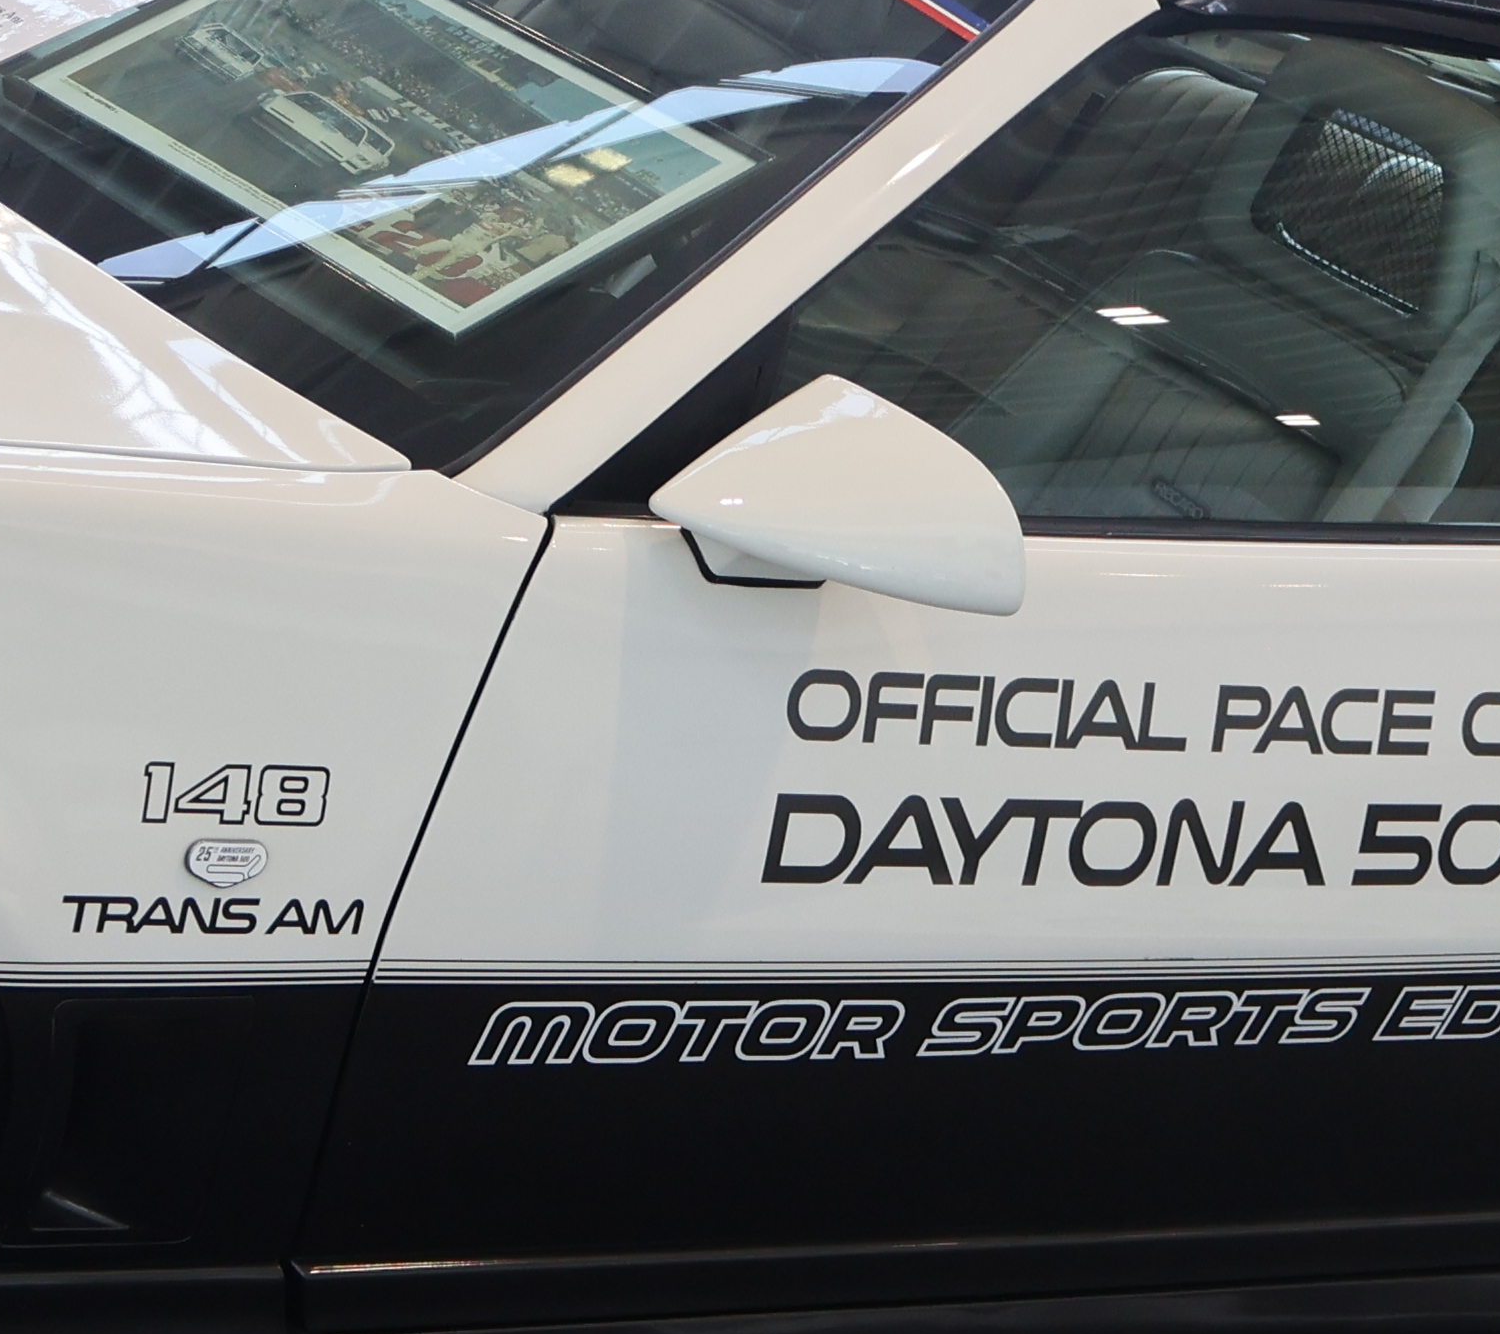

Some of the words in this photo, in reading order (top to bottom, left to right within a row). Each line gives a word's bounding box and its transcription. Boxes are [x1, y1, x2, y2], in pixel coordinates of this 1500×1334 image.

[786, 668, 1187, 751] OFFICIAL
[1211, 684, 1436, 756] PACE
[141, 761, 331, 827] 148
[760, 793, 1326, 888] DAYTONA
[62, 895, 260, 935] TRANS
[265, 898, 365, 935] AM
[467, 999, 906, 1067] MOTOR
[916, 986, 1368, 1058] SPORTS
